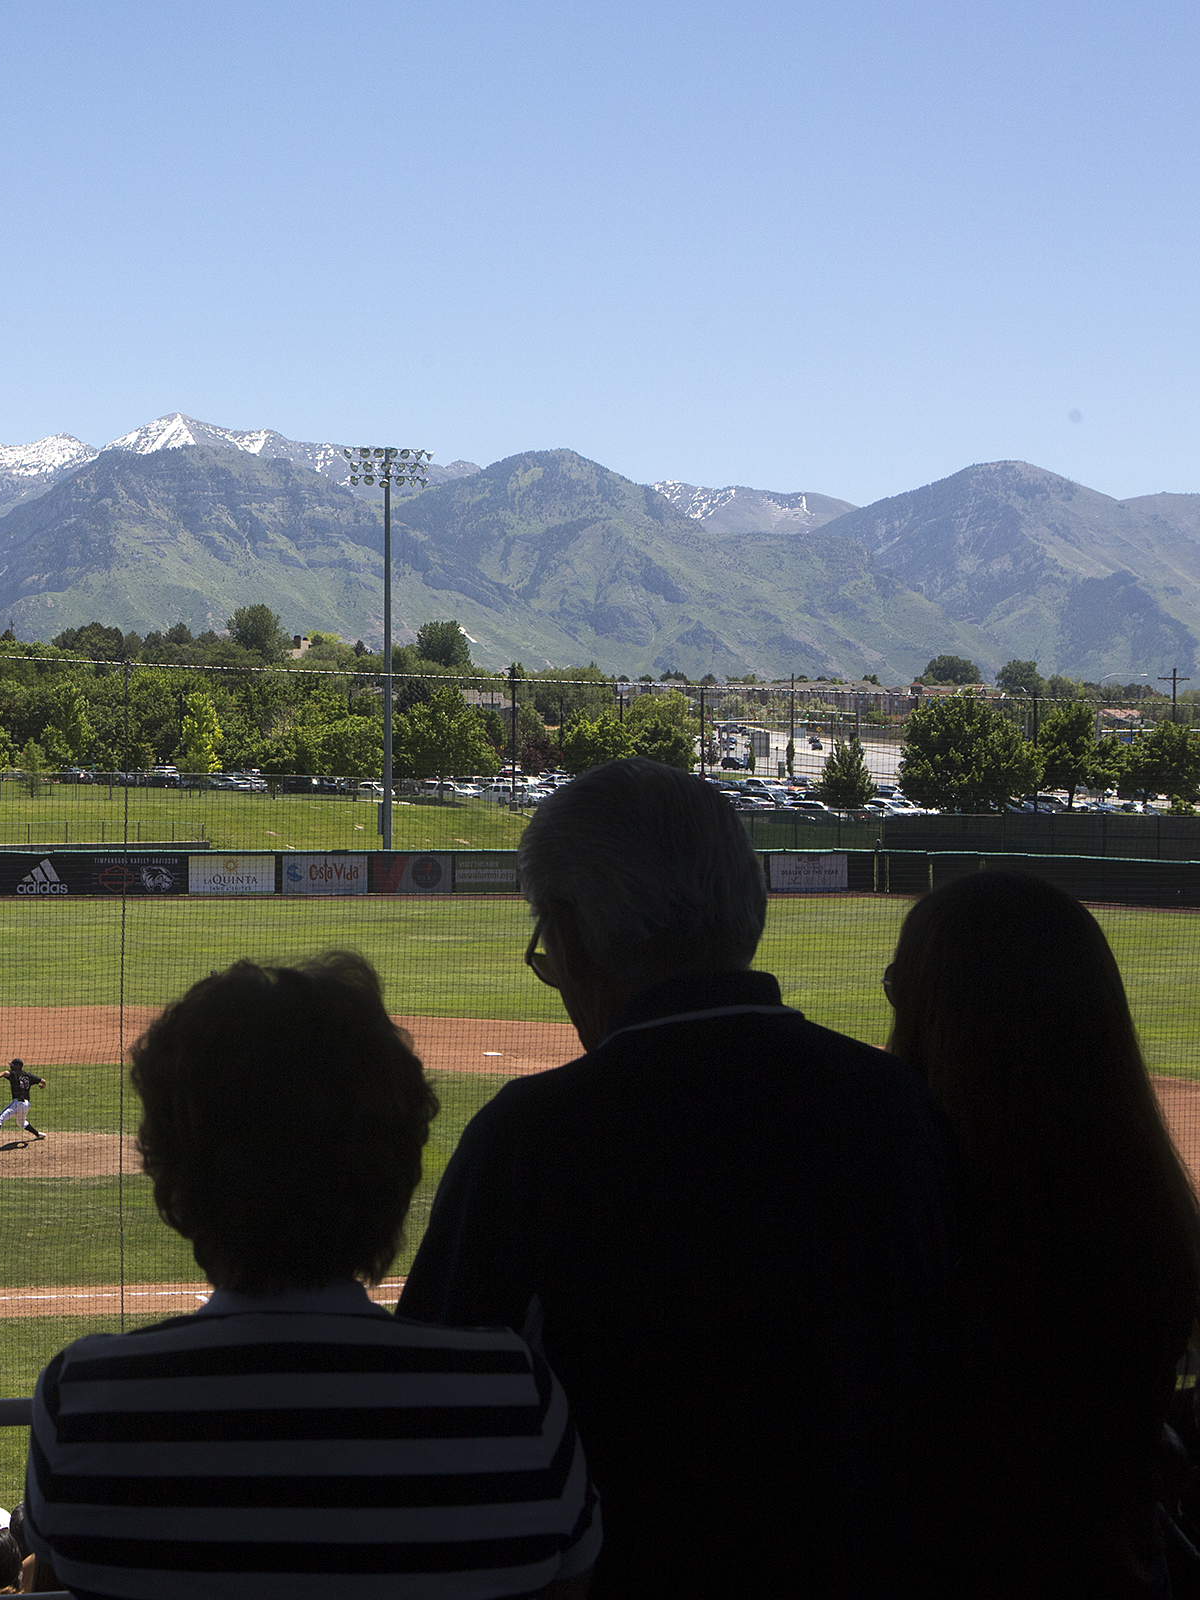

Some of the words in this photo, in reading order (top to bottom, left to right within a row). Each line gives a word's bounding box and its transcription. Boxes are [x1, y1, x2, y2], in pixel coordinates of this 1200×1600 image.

[309, 858, 333, 882] Costa
[333, 862, 359, 881] Vida
[212, 874, 258, 887] QUINTA
[16, 881, 68, 895] adidas
